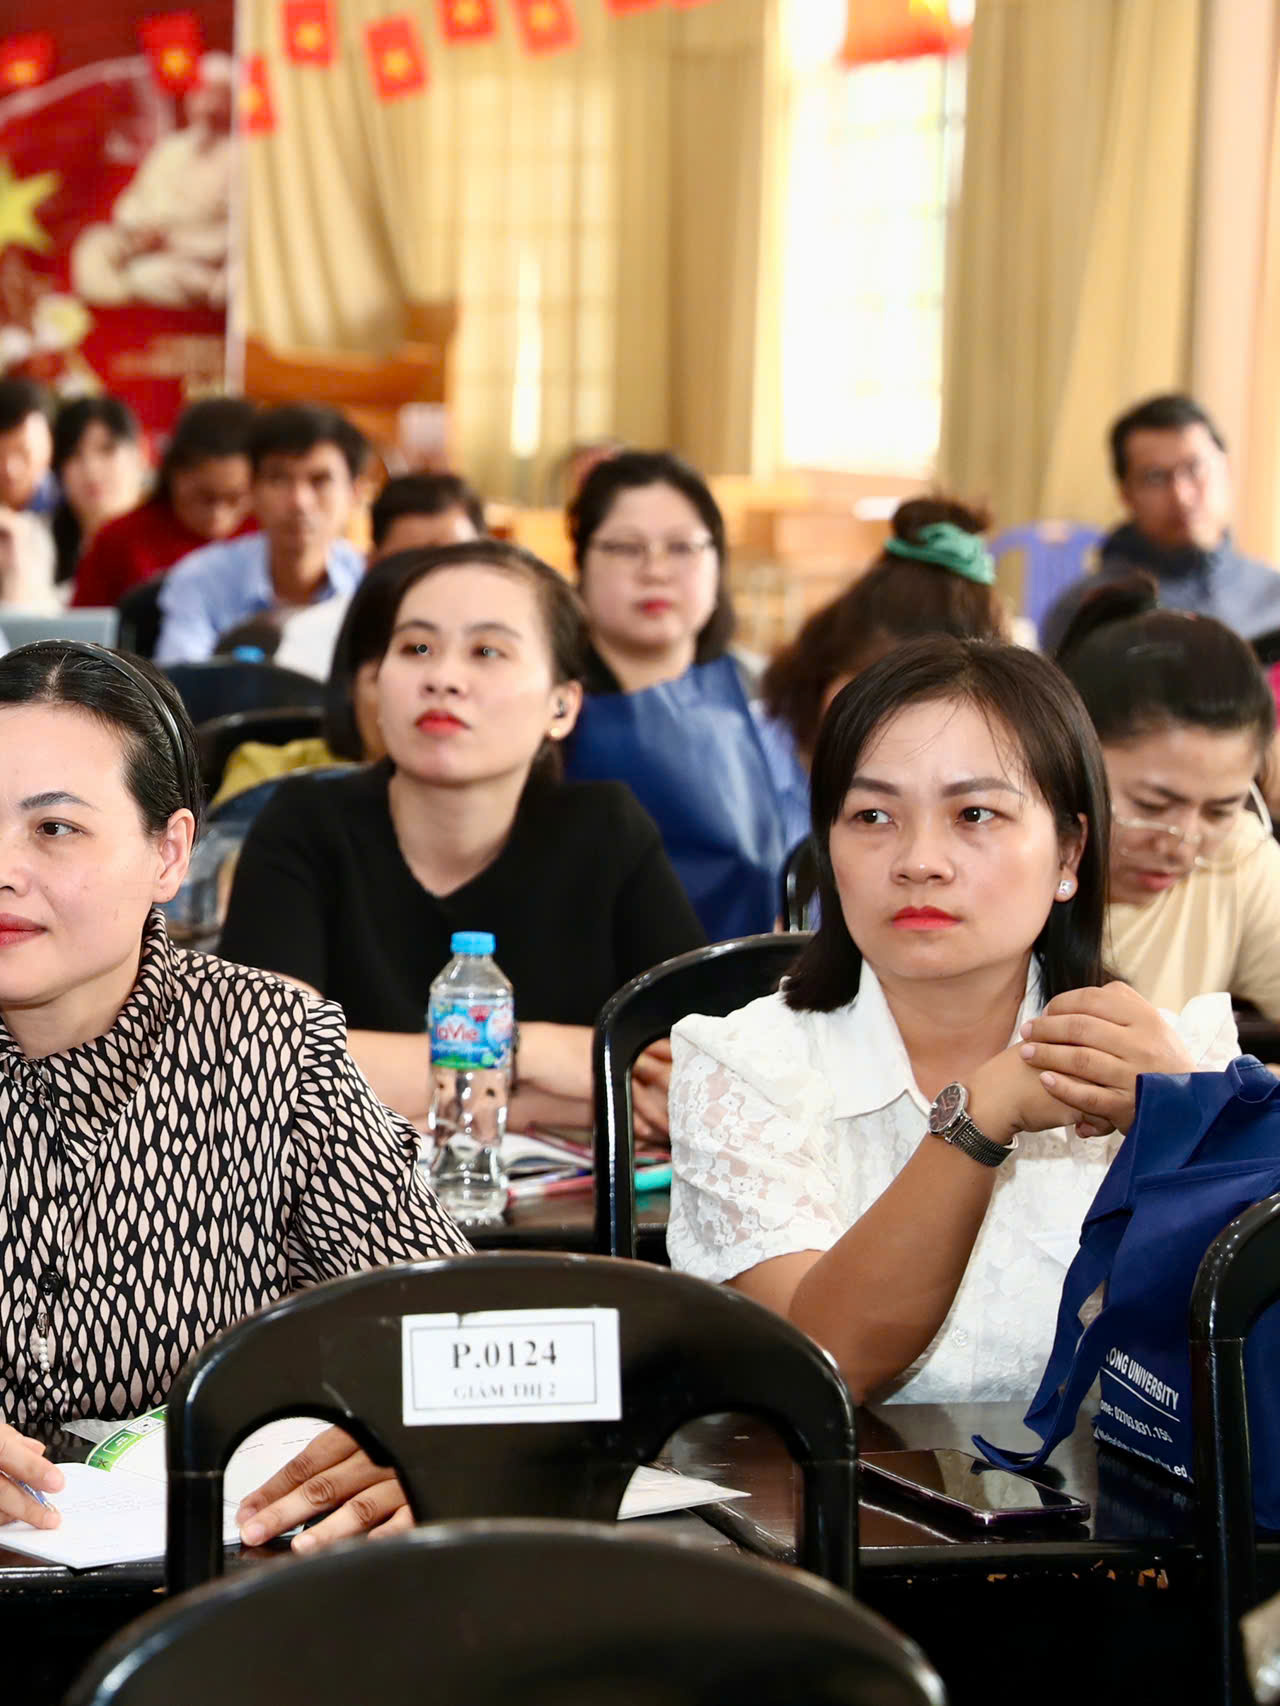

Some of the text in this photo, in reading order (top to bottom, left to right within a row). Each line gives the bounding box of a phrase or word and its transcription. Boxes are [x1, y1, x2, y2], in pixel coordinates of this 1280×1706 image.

[453, 1340, 557, 1369] P.0124
[548, 1383, 556, 1397] 2
[1128, 1360, 1179, 1410] UNIVERSITY
